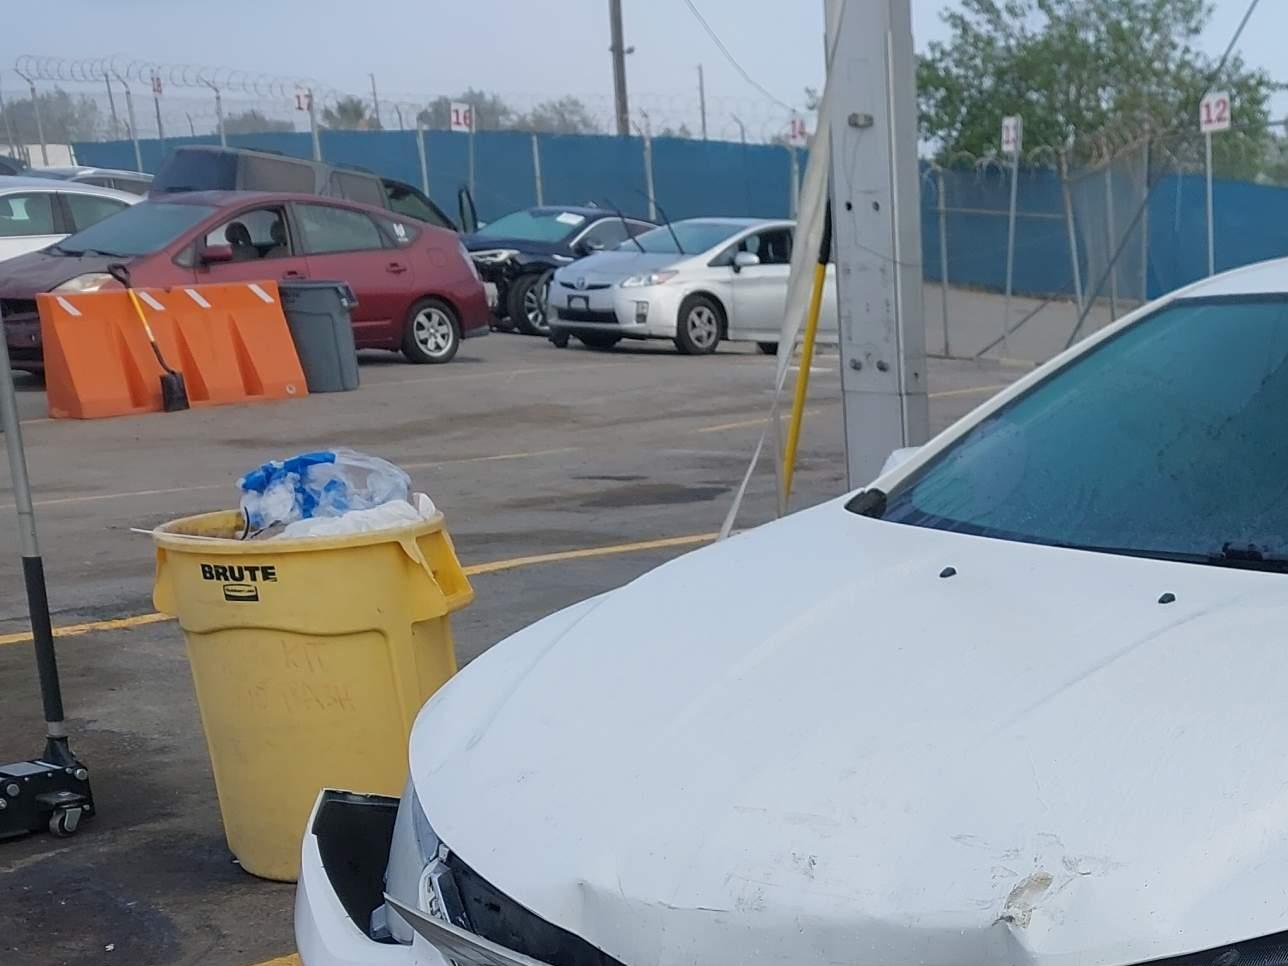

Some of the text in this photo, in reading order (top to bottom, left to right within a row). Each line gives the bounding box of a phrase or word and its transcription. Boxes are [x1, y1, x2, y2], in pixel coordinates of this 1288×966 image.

[453, 109, 472, 127] 16
[1204, 100, 1226, 123] 12
[200, 563, 278, 582] BRUTE
